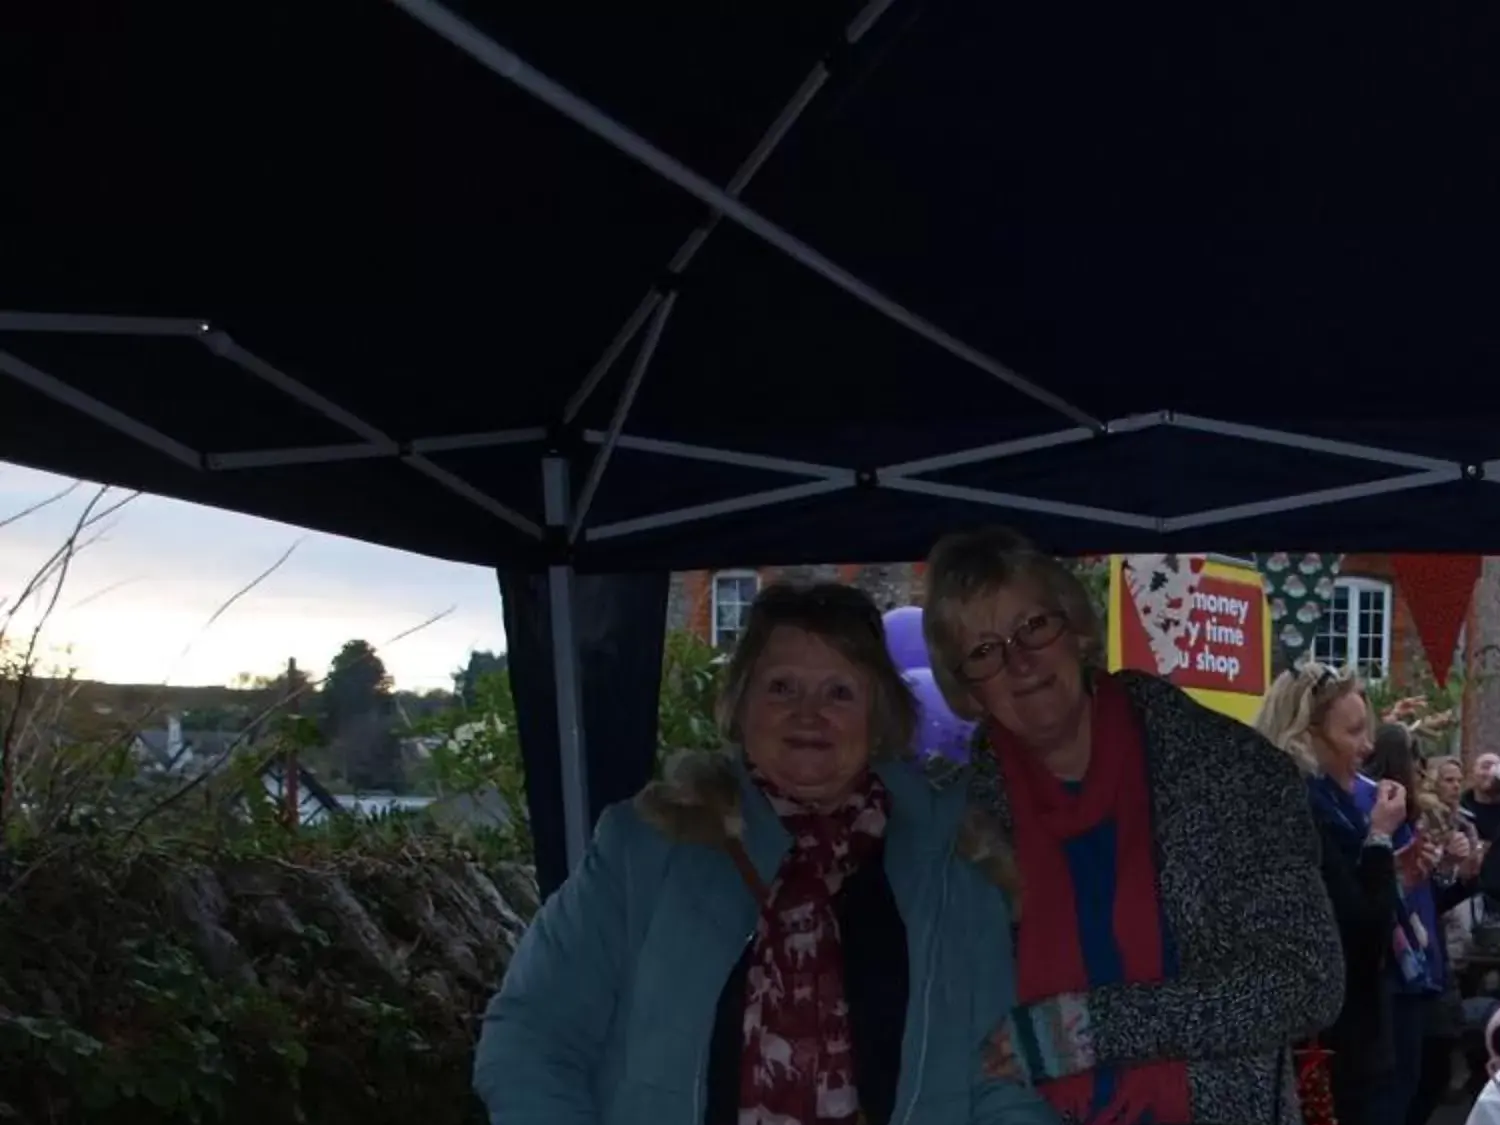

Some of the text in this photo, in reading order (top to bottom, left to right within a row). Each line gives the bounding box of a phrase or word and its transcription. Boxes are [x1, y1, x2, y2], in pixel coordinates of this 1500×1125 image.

[1191, 592, 1249, 625] money
[1205, 615, 1244, 647] time
[1195, 644, 1240, 682] shop
